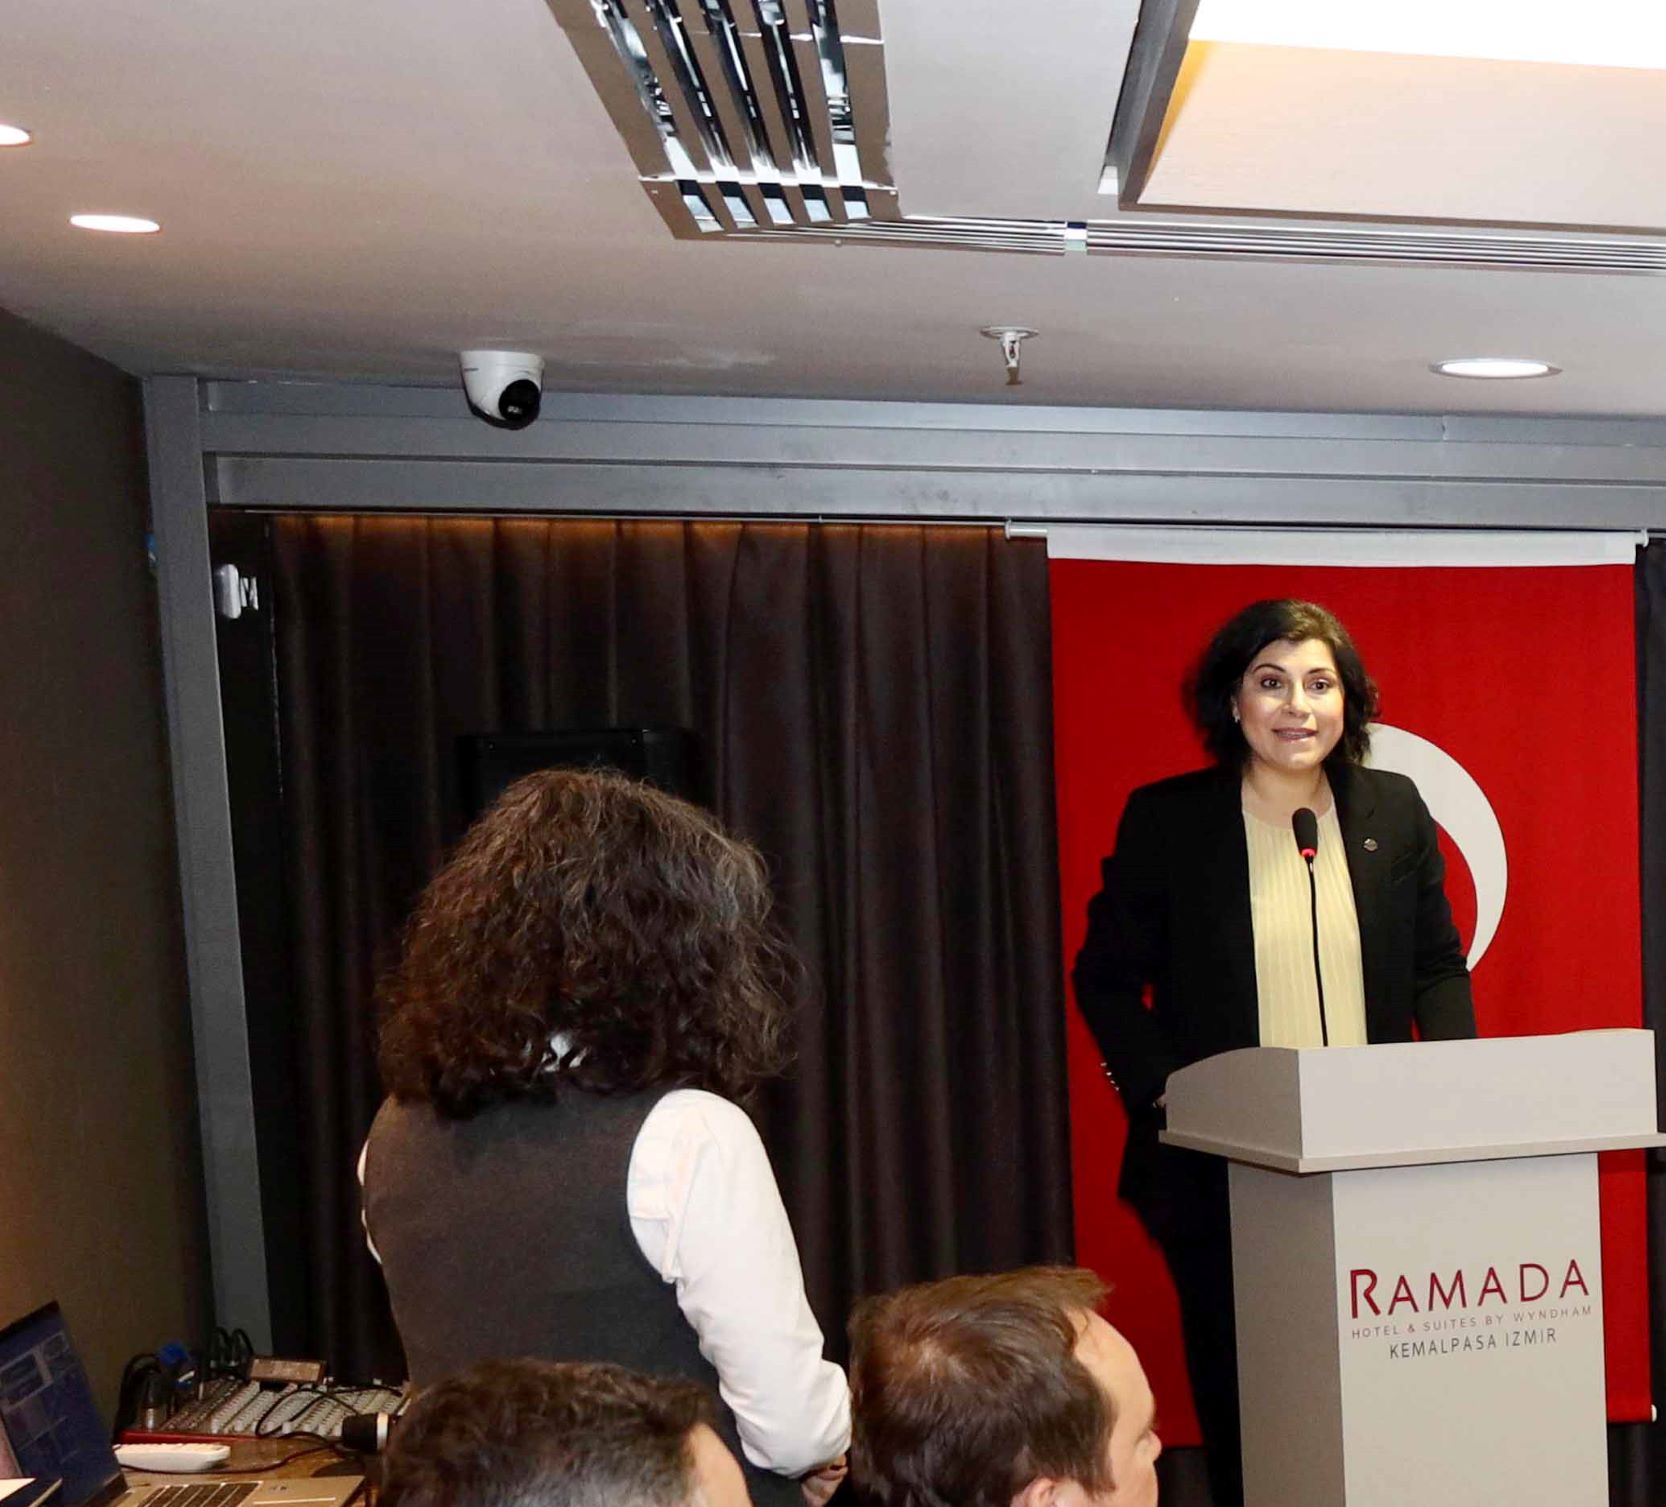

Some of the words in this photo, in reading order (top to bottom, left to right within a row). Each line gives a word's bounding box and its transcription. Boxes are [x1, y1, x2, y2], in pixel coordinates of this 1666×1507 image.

[1349, 1258, 1590, 1319] RAMADA
[1352, 1324, 1399, 1339] HOTEL
[1407, 1323, 1416, 1334] &
[1423, 1316, 1477, 1332] SUITES
[1485, 1315, 1504, 1326] BY
[1513, 1305, 1593, 1322] WYNDHAM
